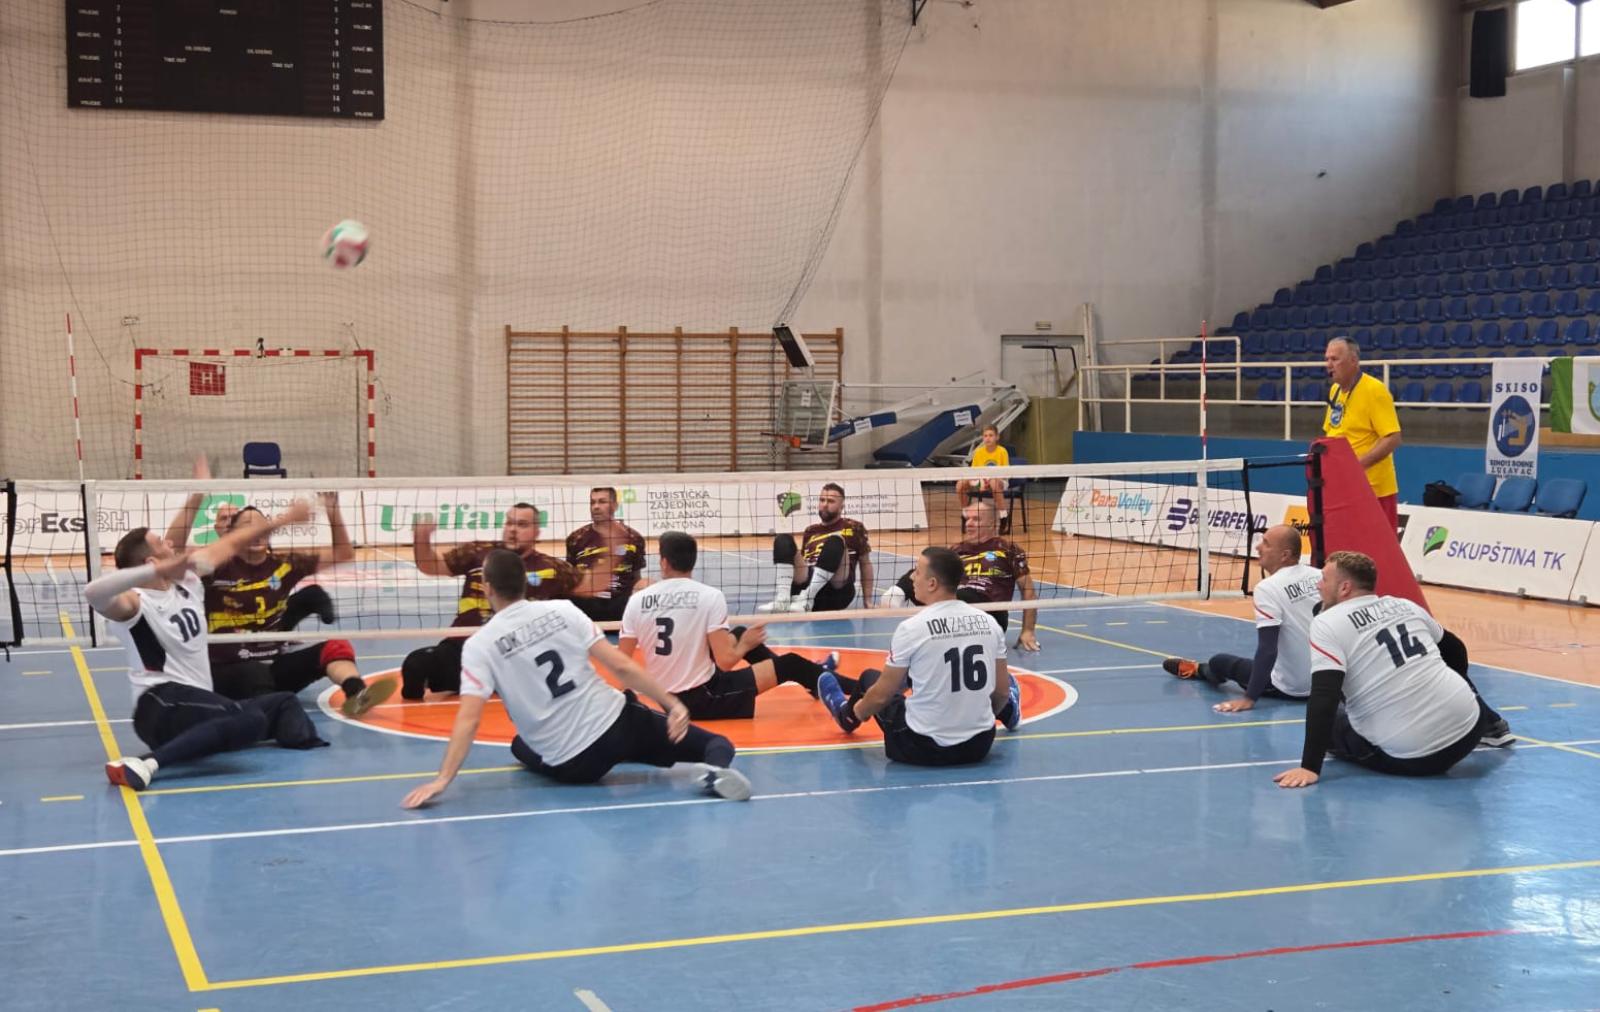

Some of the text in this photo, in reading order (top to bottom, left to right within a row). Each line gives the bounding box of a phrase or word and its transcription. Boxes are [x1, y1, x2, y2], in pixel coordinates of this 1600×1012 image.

[1495, 382, 1538, 393] SKISO
[1446, 540, 1566, 571] SKUPŠTINA TK
[169, 607, 201, 643] 10
[655, 617, 675, 656] 3
[1375, 623, 1428, 668] 14
[534, 649, 577, 698] 2
[943, 644, 988, 693] 16
